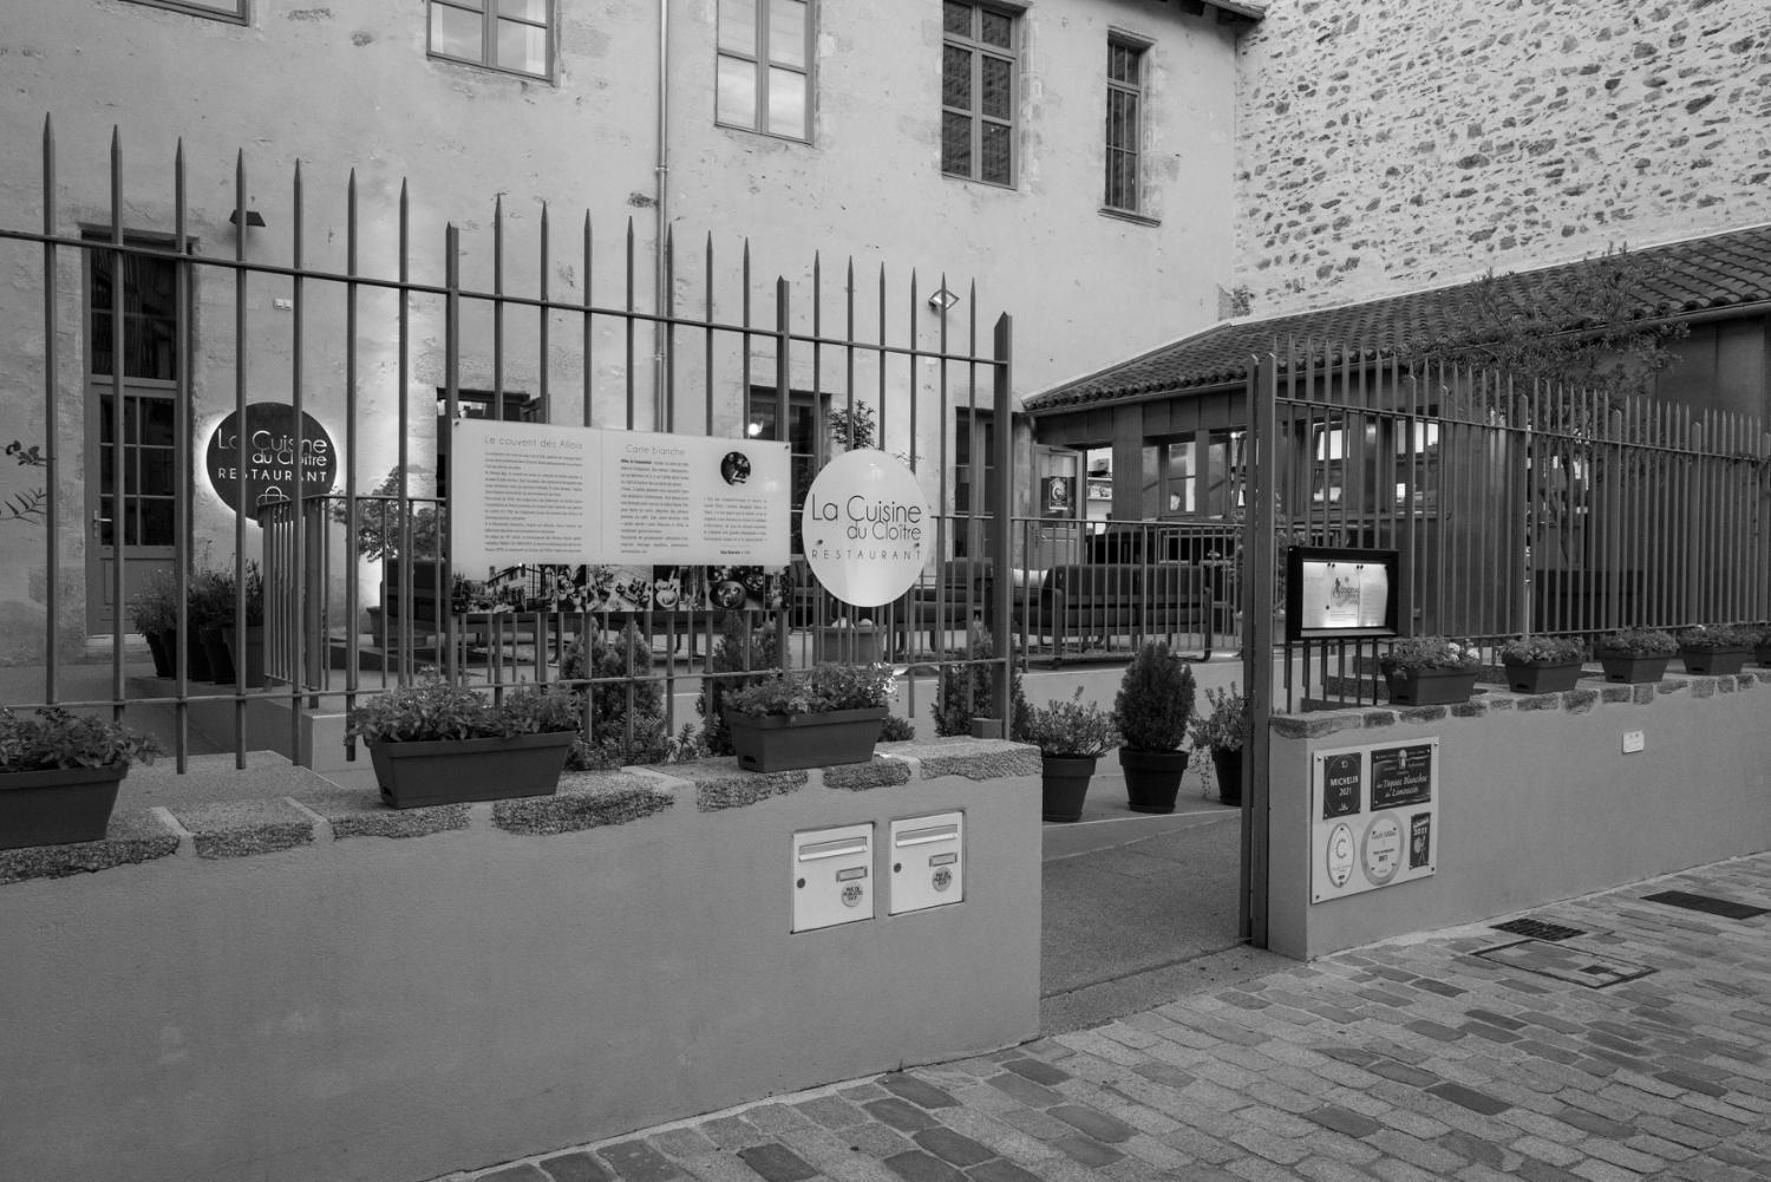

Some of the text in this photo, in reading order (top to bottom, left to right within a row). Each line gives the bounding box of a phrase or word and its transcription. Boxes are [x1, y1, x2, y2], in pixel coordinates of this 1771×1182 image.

[252, 430, 327, 453] Cuisne
[252, 449, 327, 466] du Clître
[218, 467, 327, 482] RETAURNT
[812, 493, 922, 524] La Cuisine
[847, 520, 922, 541] du Cloître
[812, 549, 921, 561] RESTAURANT
[1330, 775, 1358, 787] MICHELIN
